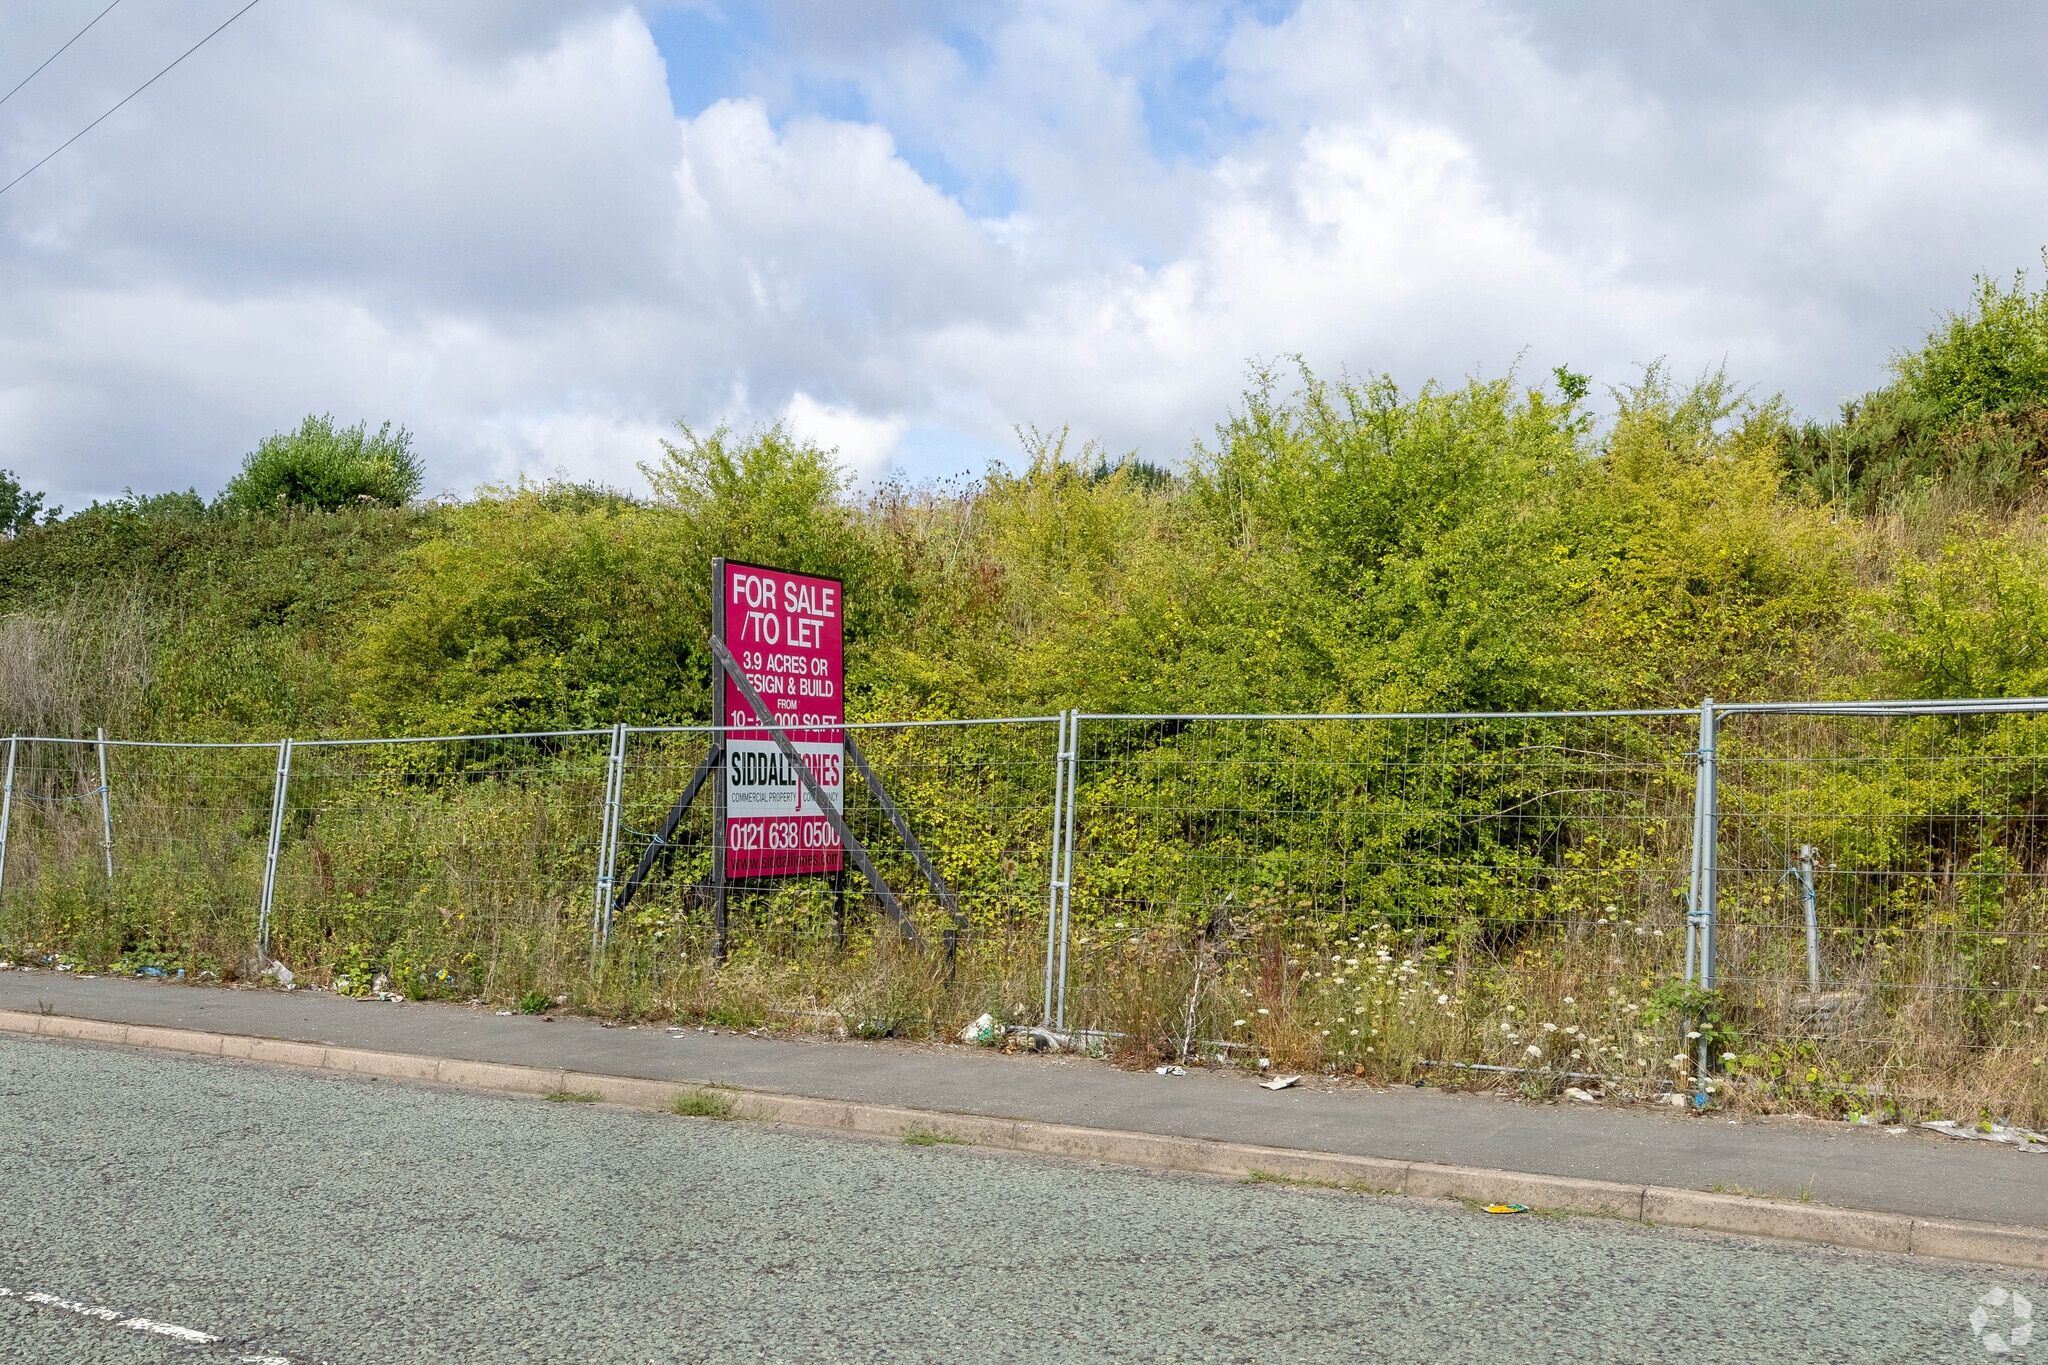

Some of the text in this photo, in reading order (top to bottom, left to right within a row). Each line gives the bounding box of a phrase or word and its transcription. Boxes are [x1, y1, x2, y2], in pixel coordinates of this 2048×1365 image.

[733, 573, 835, 617] FOR SALE
[741, 610, 824, 649] /TO LET
[743, 651, 828, 676] 3.9 ACRES OR
[737, 673, 834, 698] ESIGN & BUILD
[777, 699, 797, 710] FROM
[732, 752, 796, 786] SIDDALL
[732, 792, 768, 803] COMMERCIAL
[769, 792, 797, 802] PROPERTY
[730, 821, 841, 851] 0121 638 0500
[731, 852, 839, 870] www.siddalljones.com
